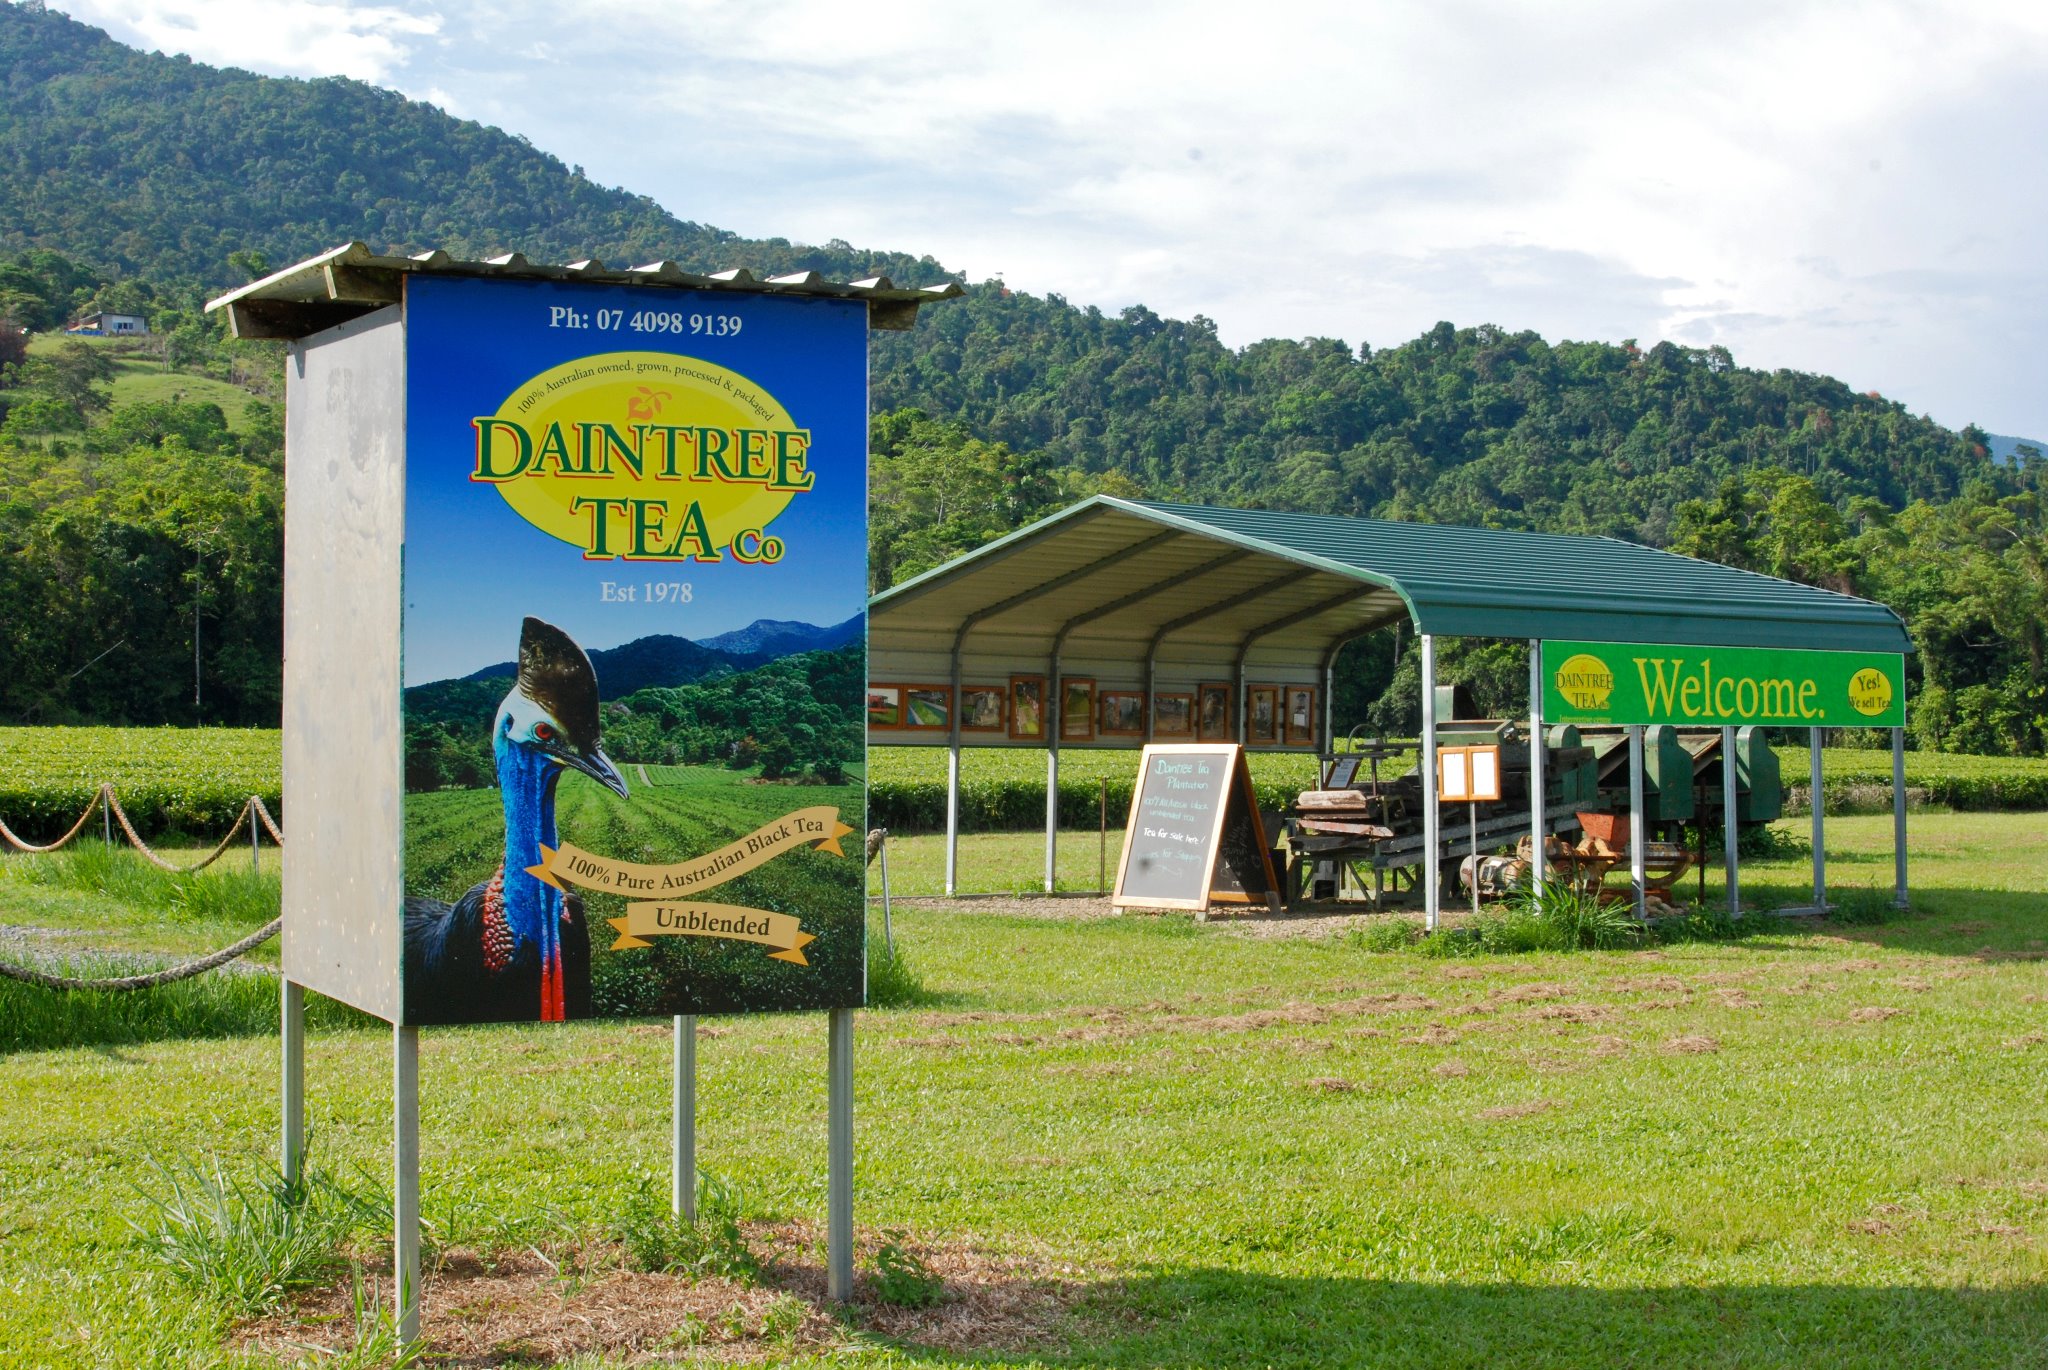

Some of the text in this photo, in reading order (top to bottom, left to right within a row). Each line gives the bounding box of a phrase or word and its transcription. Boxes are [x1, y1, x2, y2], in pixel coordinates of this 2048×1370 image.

[549, 306, 743, 337] Ph: 07 4098 9139
[517, 360, 775, 422] 100% Australian owned, grown, processed & packaged
[470, 416, 815, 493] DAINTREE
[569, 495, 785, 565] TEA Co
[601, 581, 693, 604] Est 1978
[1555, 672, 1614, 690] DAINTREE
[1632, 657, 1826, 719] Welcome.
[1857, 672, 1881, 692] Yes!
[1572, 692, 1598, 708] TEA
[1848, 695, 1860, 708] We
[1862, 696, 1875, 708] sell
[1144, 827, 1156, 837] Tea
[1158, 828, 1168, 838] for
[1169, 832, 1184, 842] sale
[566, 817, 824, 890] 100% Pure Australian Black Tea
[655, 907, 771, 937] Unblended
